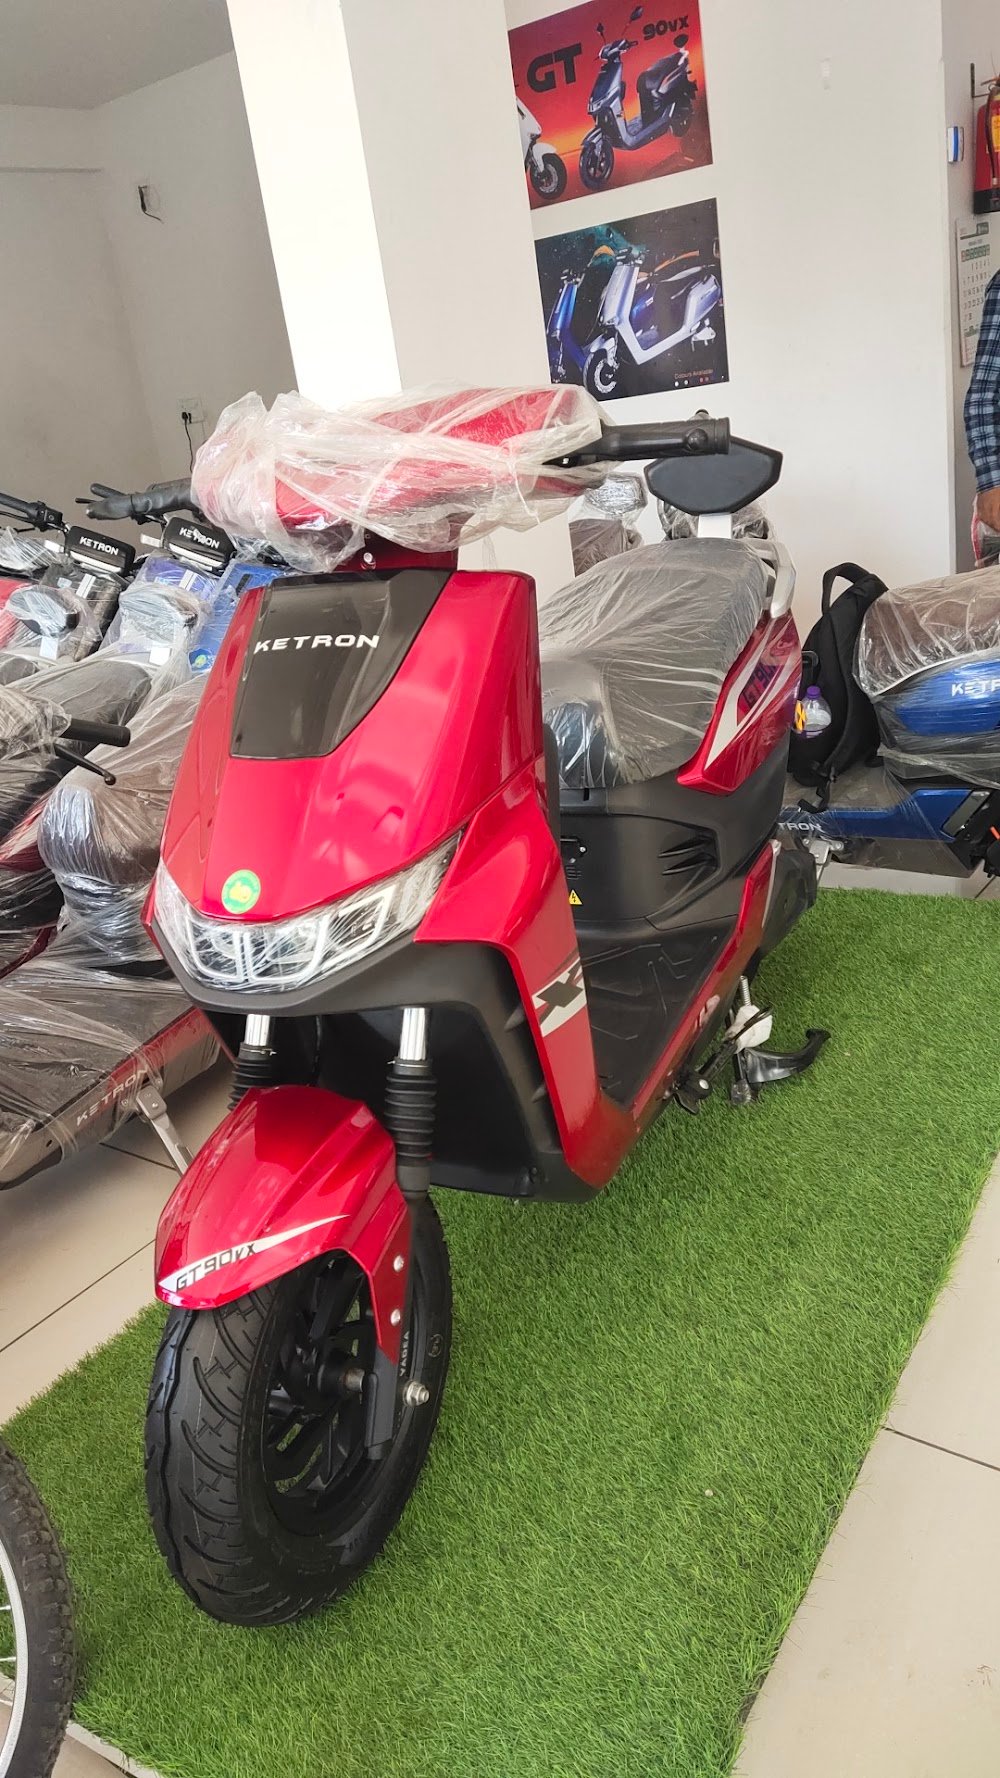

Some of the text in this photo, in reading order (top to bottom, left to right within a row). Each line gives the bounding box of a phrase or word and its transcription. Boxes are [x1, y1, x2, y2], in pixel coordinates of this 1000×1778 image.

[527, 43, 582, 93] GT
[79, 536, 119, 556] KETRON
[253, 634, 380, 655] KETRON
